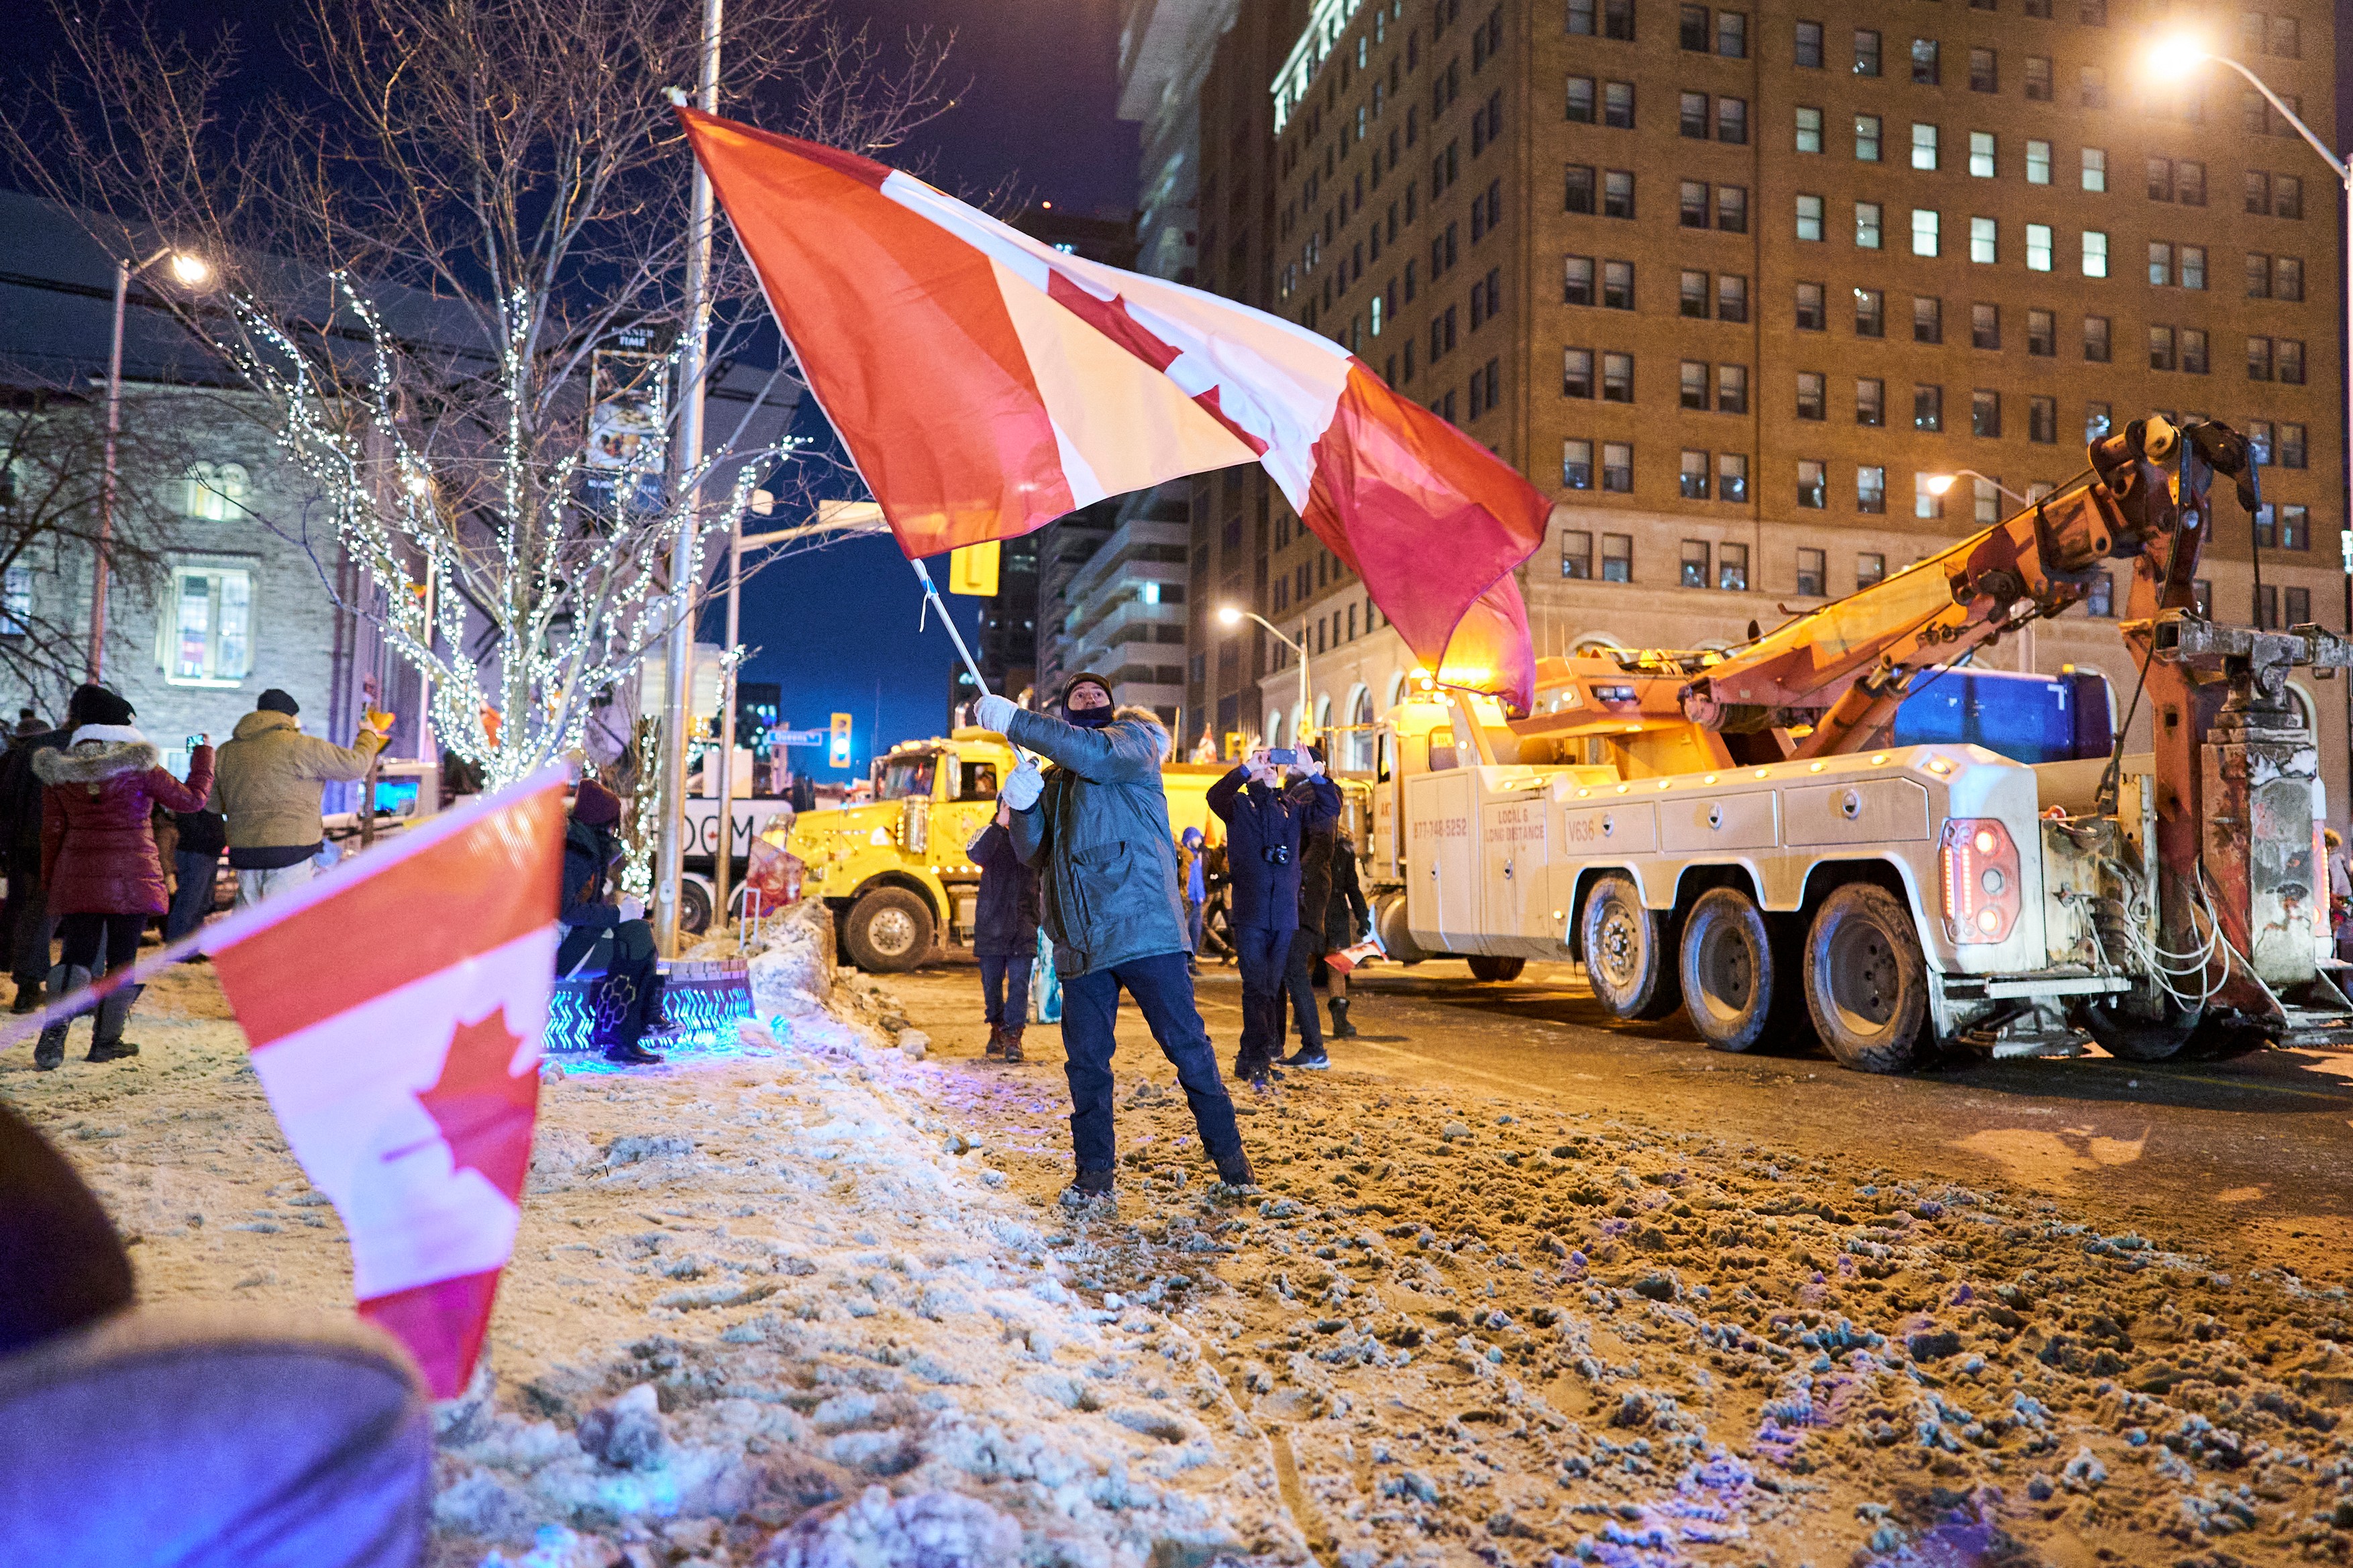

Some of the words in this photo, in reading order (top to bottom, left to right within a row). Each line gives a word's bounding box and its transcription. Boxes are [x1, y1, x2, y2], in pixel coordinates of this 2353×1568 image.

[619, 336, 645, 346] TIME
[1498, 808, 1522, 825] LOCAL
[1485, 827, 1506, 843] LONG
[1506, 824, 1544, 841] DISTANCE
[1569, 819, 1596, 843] V636
